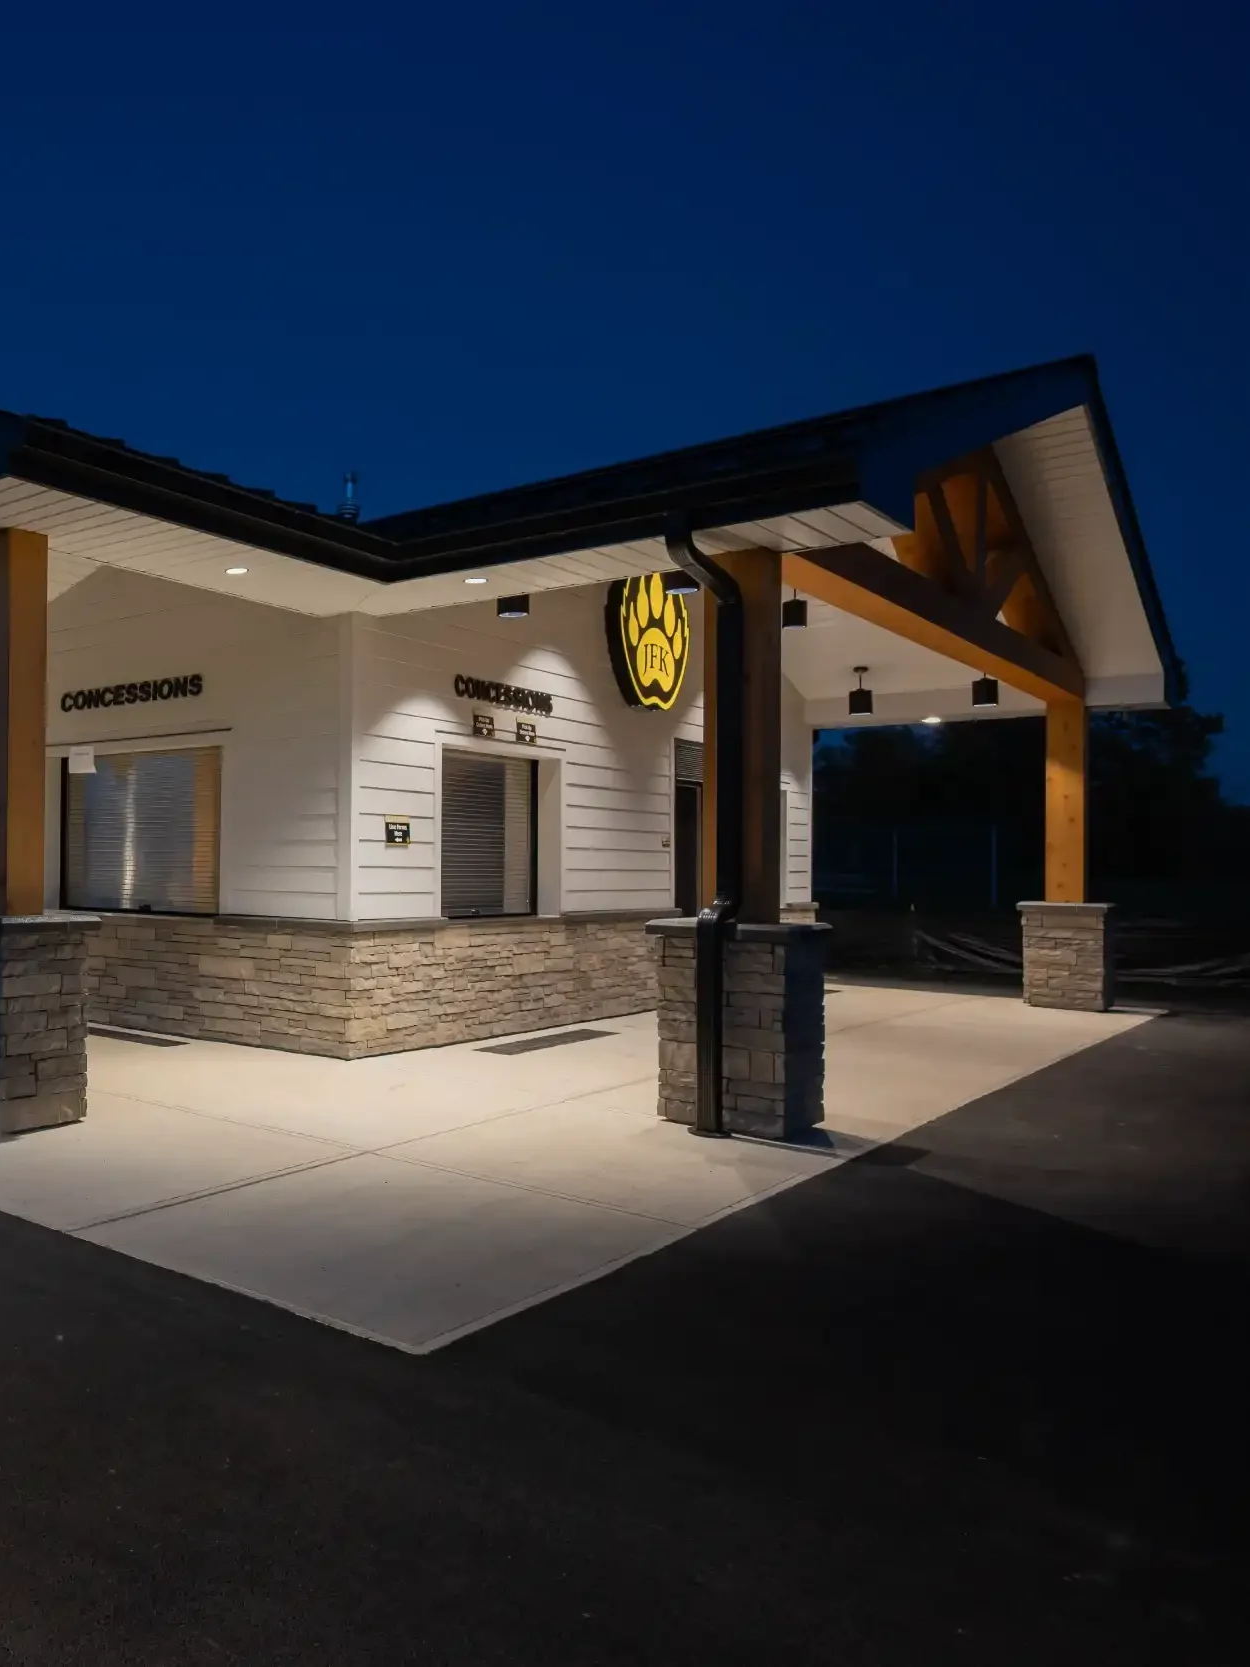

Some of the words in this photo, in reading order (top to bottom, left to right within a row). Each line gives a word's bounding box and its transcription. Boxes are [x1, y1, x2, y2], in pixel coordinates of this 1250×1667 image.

[643, 643, 670, 677] JFK
[60, 673, 203, 712] CONCESSIONS
[454, 673, 554, 717] CONCESSIONS
